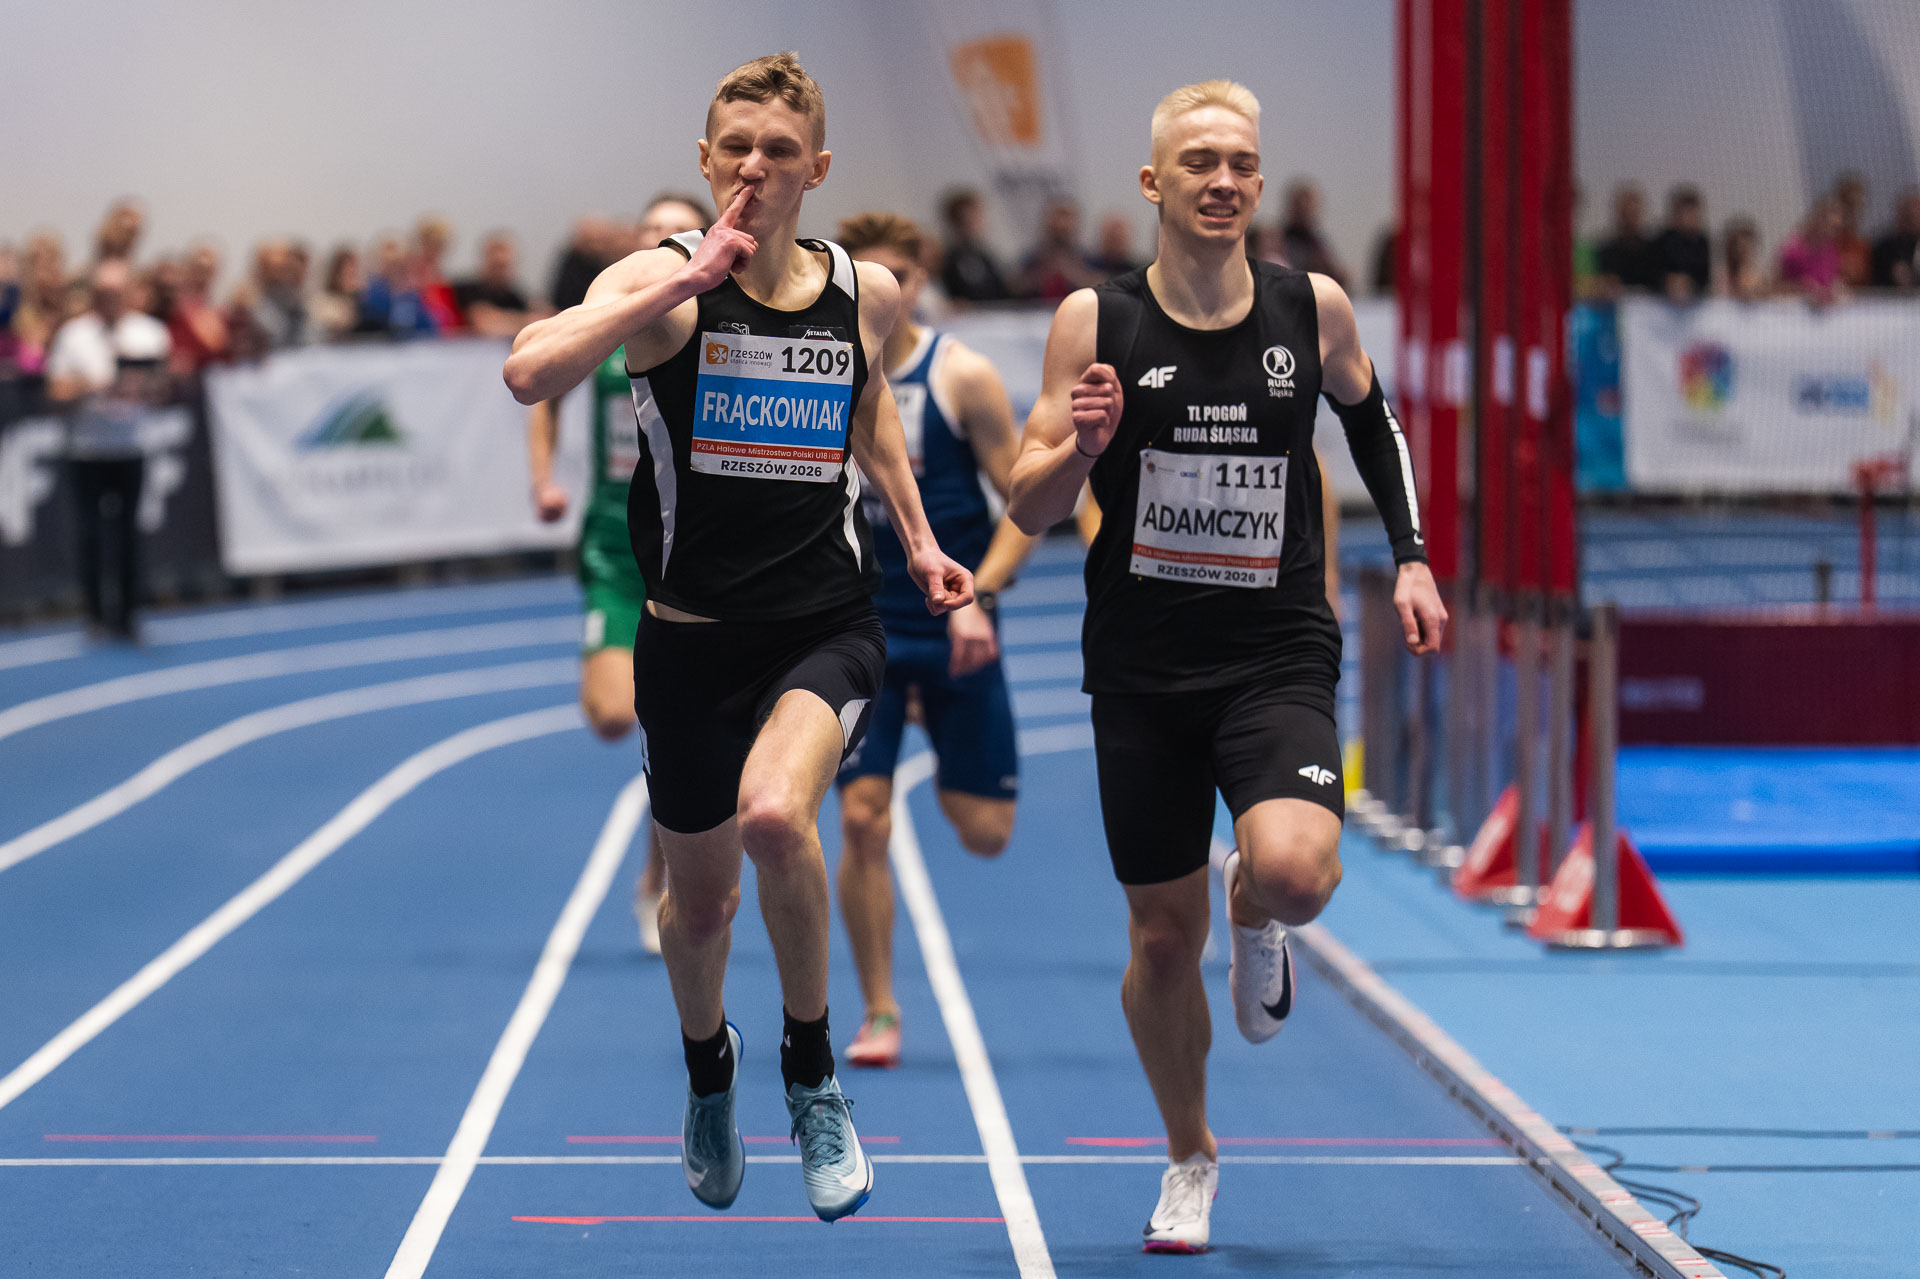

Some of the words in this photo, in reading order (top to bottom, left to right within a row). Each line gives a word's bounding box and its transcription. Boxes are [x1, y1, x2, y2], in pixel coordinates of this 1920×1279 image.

[730, 349, 773, 360] rzeszów
[781, 347, 850, 376] 1209
[1138, 365, 1178, 388] 4F
[1268, 378, 1295, 388] RUDA
[1269, 387, 1294, 398] Śląska
[702, 391, 845, 431] FRĄCKOWIAK
[1204, 402, 1247, 422] POGOŃ
[1173, 427, 1207, 443] RUDA
[1210, 424, 1258, 445] ŚLĄSKA
[696, 443, 715, 452] PZLA
[717, 443, 746, 454] Halowe
[748, 447, 791, 458] Mistrzostwa
[793, 450, 814, 460] Polski
[815, 451, 828, 460] U18
[721, 460, 786, 476] RZESZÓW
[790, 465, 822, 477] 2026
[1216, 462, 1282, 489] 1111
[1142, 502, 1278, 540] ADAMCZYK
[1157, 564, 1221, 581] RZESZÓW
[1224, 570, 1256, 583] 2026
[1298, 764, 1337, 787] 4F
